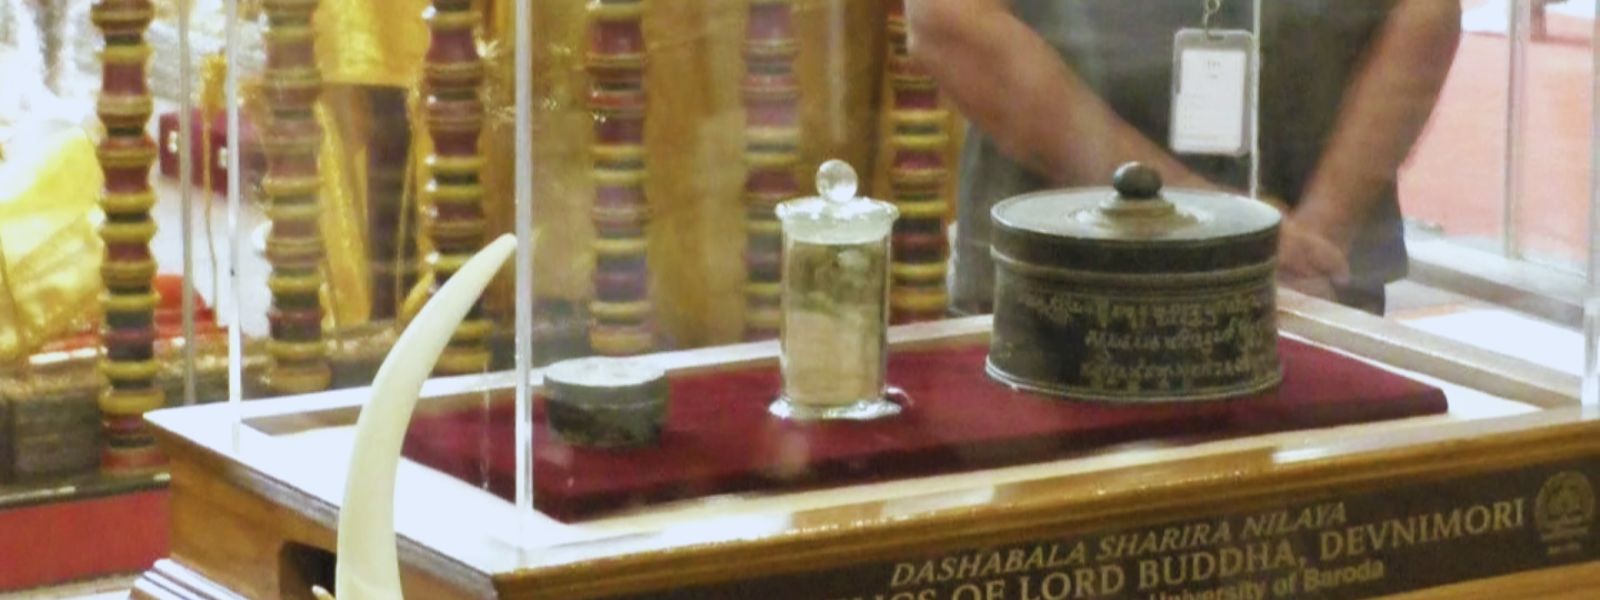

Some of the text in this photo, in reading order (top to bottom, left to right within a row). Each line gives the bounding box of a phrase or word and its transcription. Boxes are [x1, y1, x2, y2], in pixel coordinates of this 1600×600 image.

[890, 502, 1346, 587] DASHABALA SHARIRA NILAYA
[952, 498, 1526, 600] OF LORD BUDDHA, DEVNIMORI
[1271, 571, 1297, 597] of
[1303, 559, 1384, 593] Baroda
